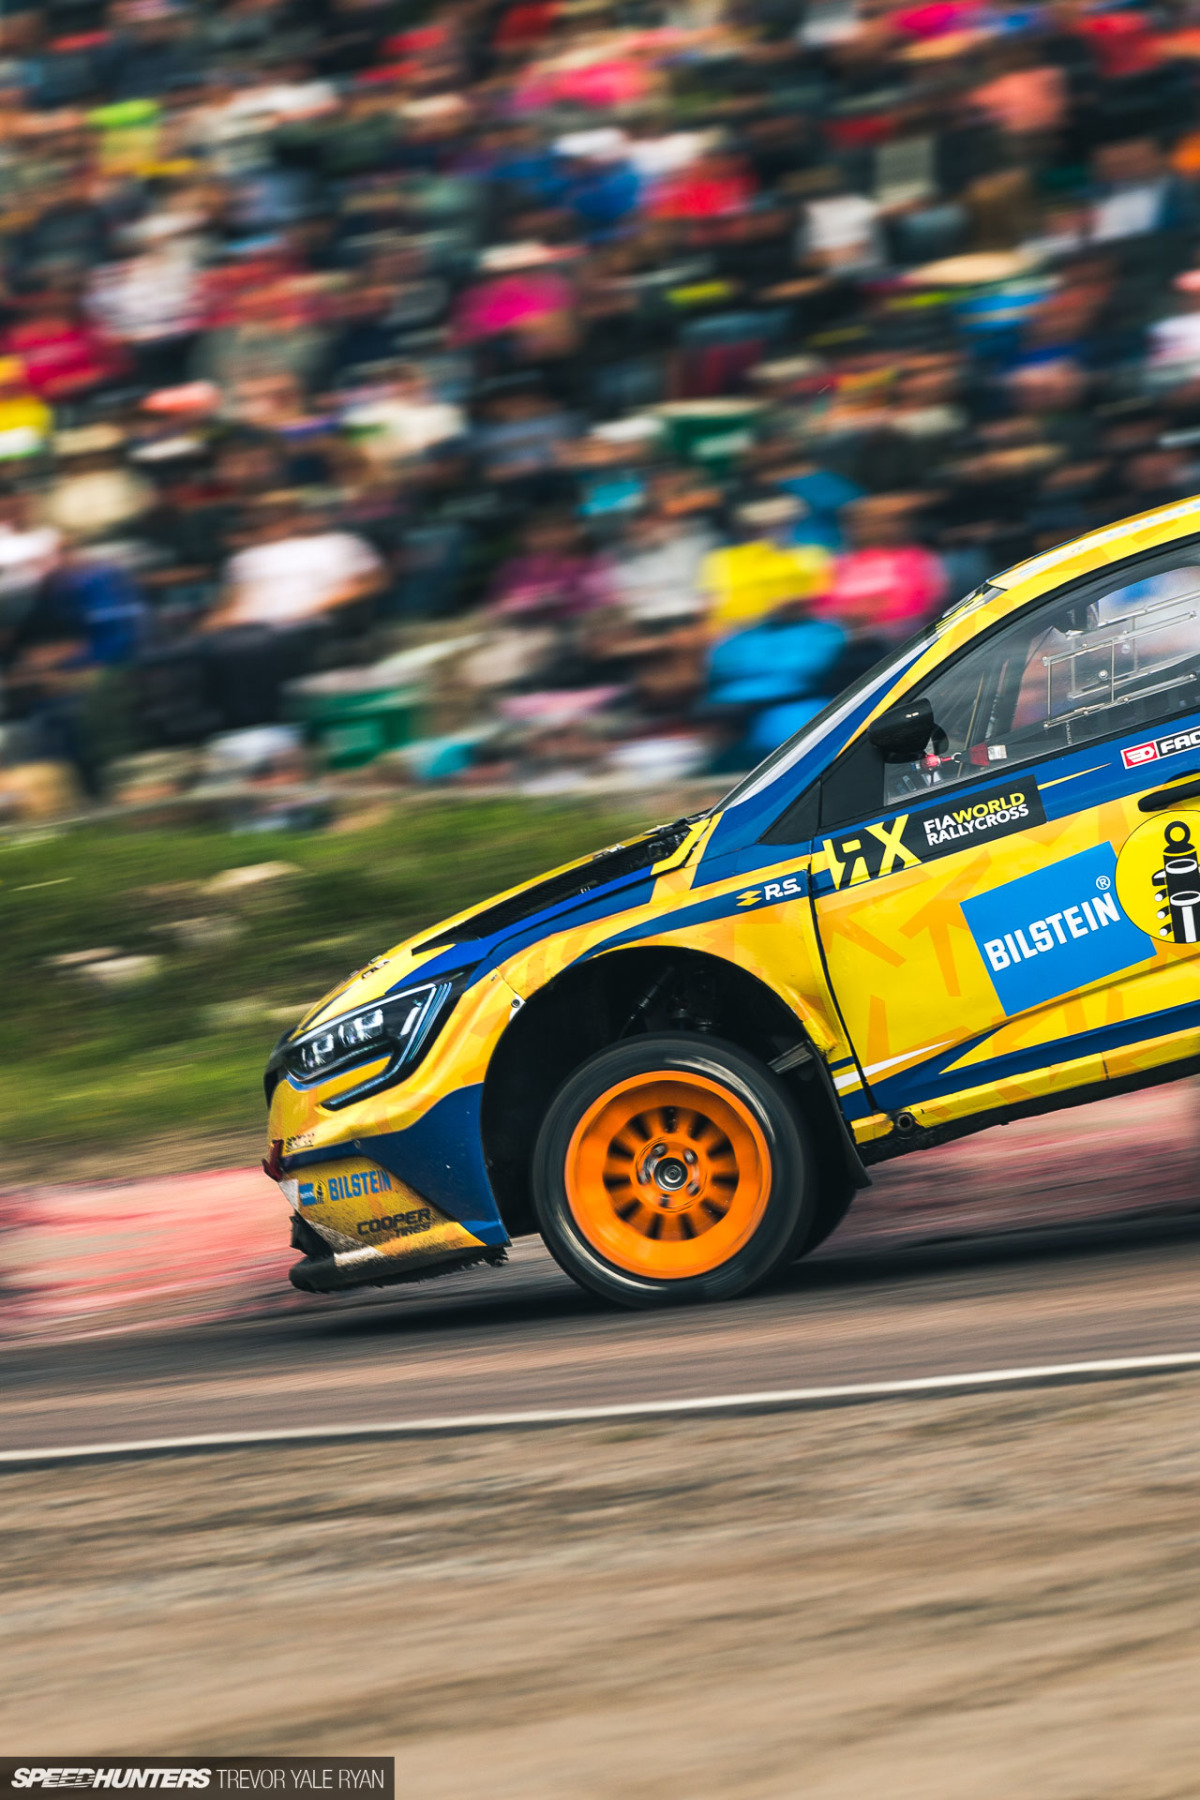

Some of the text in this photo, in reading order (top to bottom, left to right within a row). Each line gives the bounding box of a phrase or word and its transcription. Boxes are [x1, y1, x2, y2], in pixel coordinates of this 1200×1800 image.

[926, 803, 1029, 846] RALLYCROSS
[983, 892, 1121, 972] BILSTEIN
[328, 1170, 392, 1202] BILSTEIN
[357, 1208, 430, 1235] COOPER
